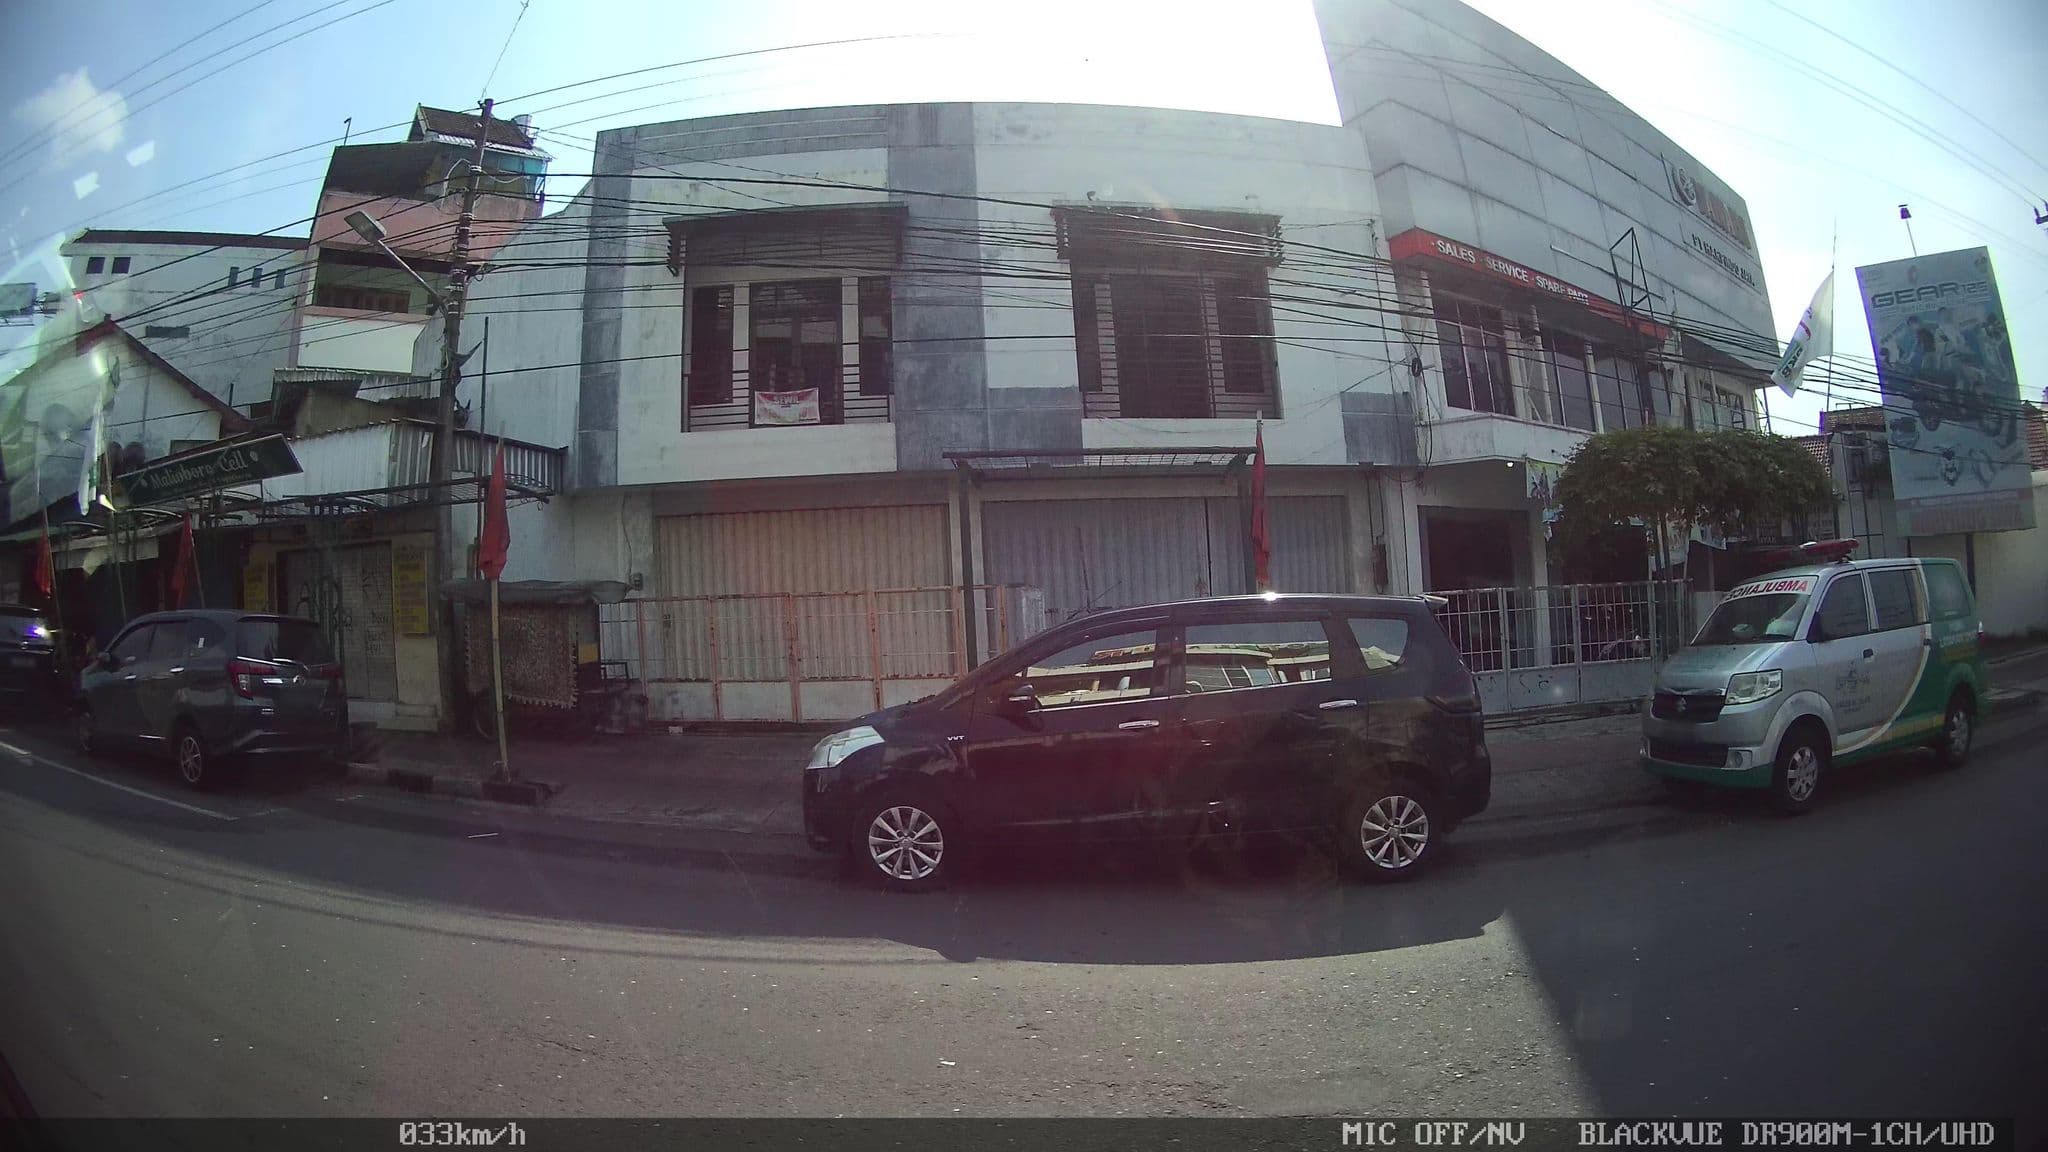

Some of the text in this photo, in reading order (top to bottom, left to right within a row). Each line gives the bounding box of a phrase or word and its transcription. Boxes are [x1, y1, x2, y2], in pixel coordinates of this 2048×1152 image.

[1437, 240, 1476, 264] SALES
[1485, 257, 1529, 283] SERVICE
[1535, 275, 1566, 295] SPARE
[1871, 281, 1960, 308] GEAR
[216, 448, 249, 473] Cell
